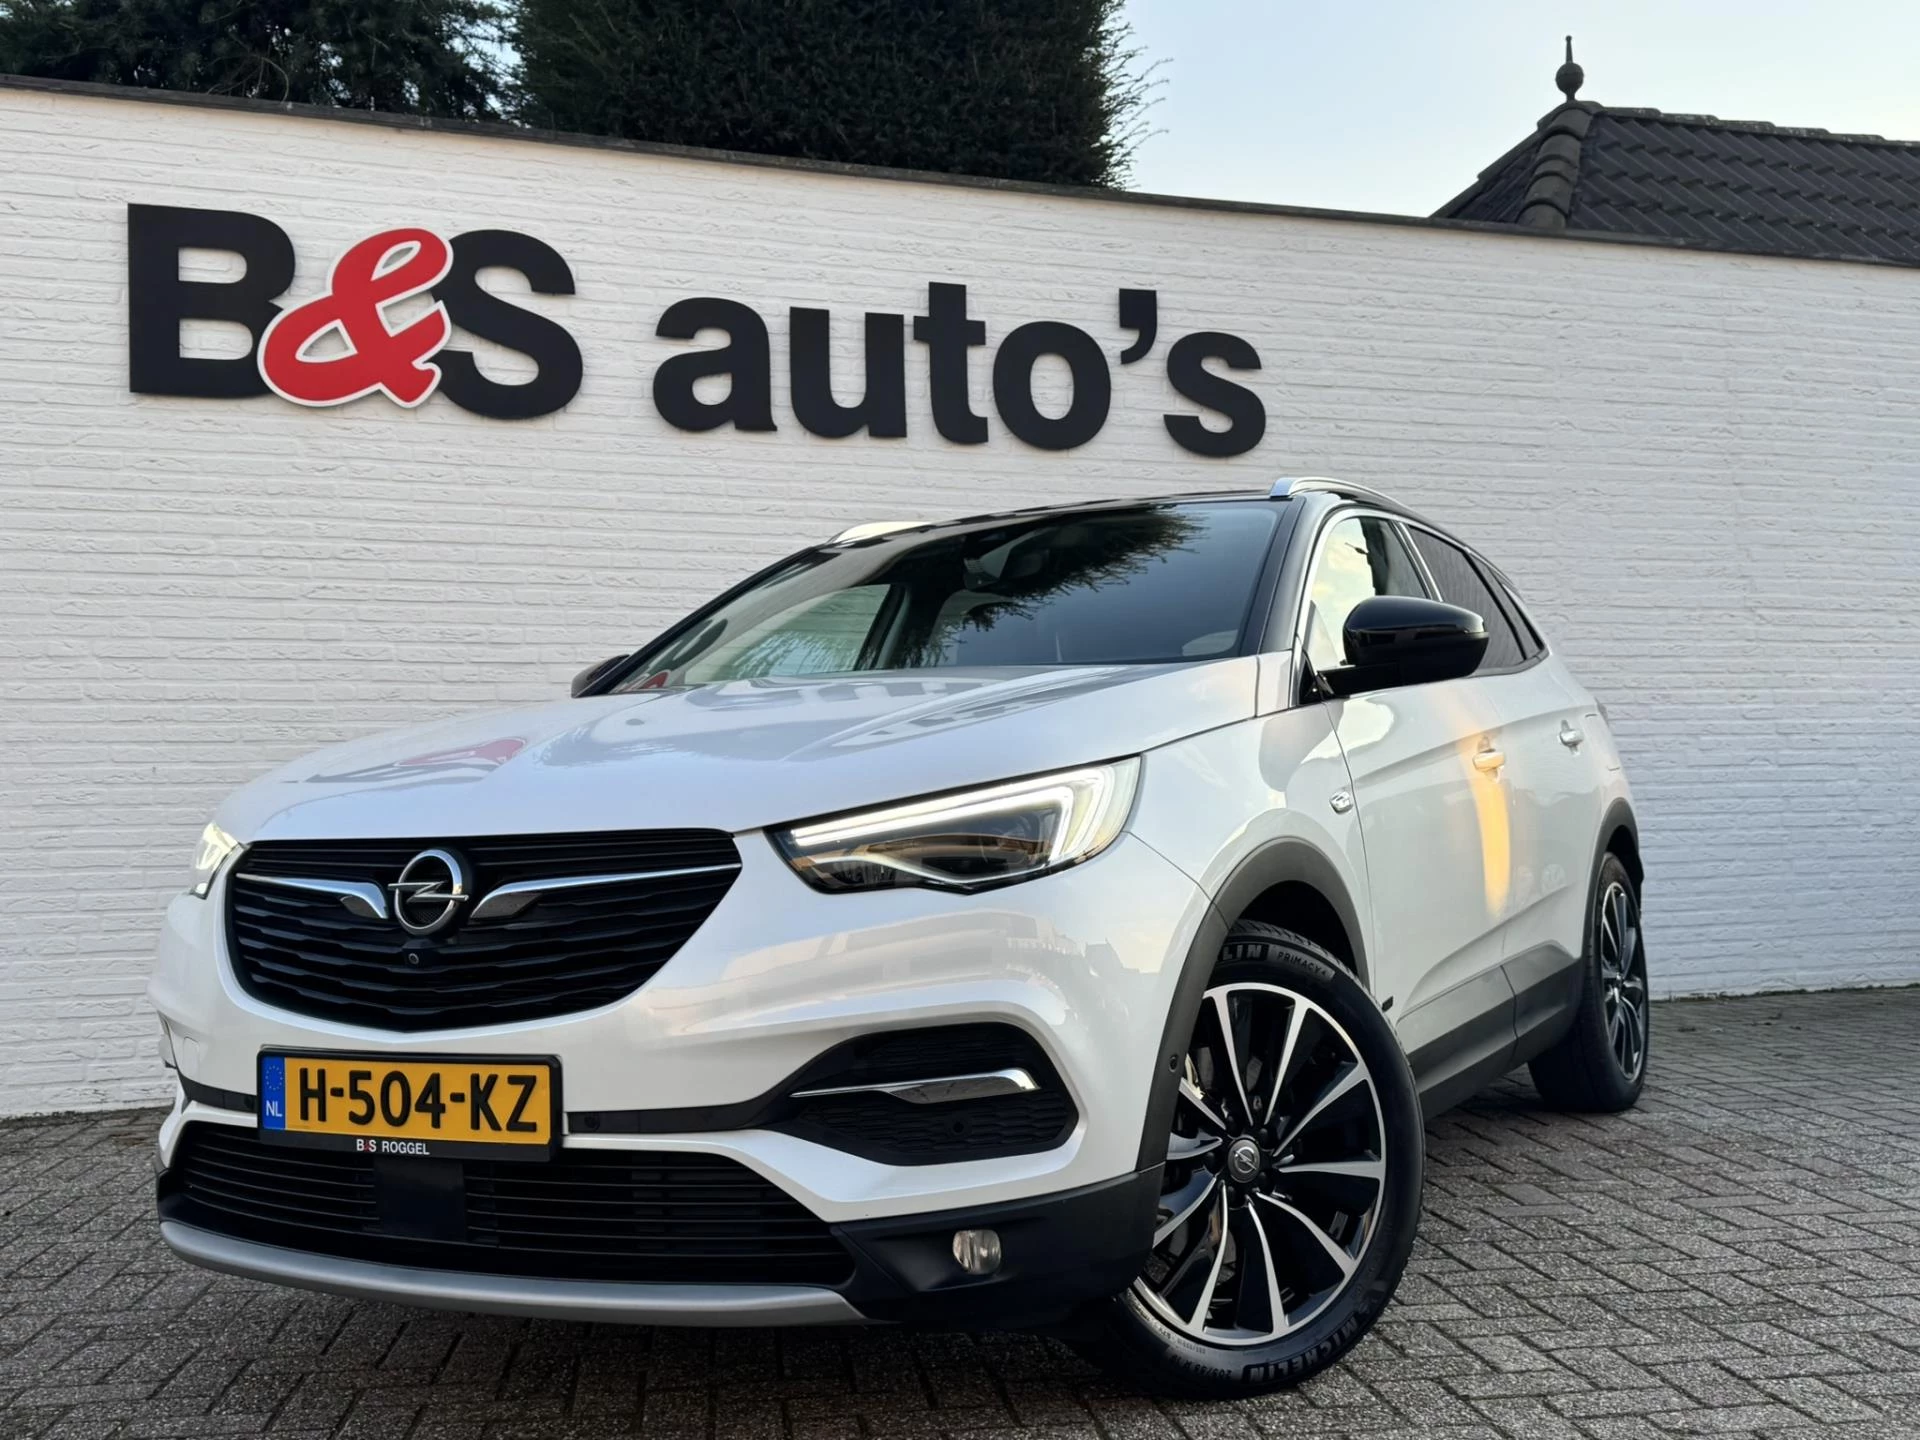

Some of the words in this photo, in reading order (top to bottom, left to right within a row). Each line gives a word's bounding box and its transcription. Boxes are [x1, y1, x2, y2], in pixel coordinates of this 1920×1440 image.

[128, 203, 584, 420] B&S
[653, 281, 1267, 459] auto's
[1278, 951, 1320, 974] PRIMACY
[266, 1100, 282, 1118] NL
[299, 1067, 538, 1133] H-504-KZ
[382, 1140, 430, 1155] ROGGEL
[1250, 1318, 1360, 1382] MICHELIN
